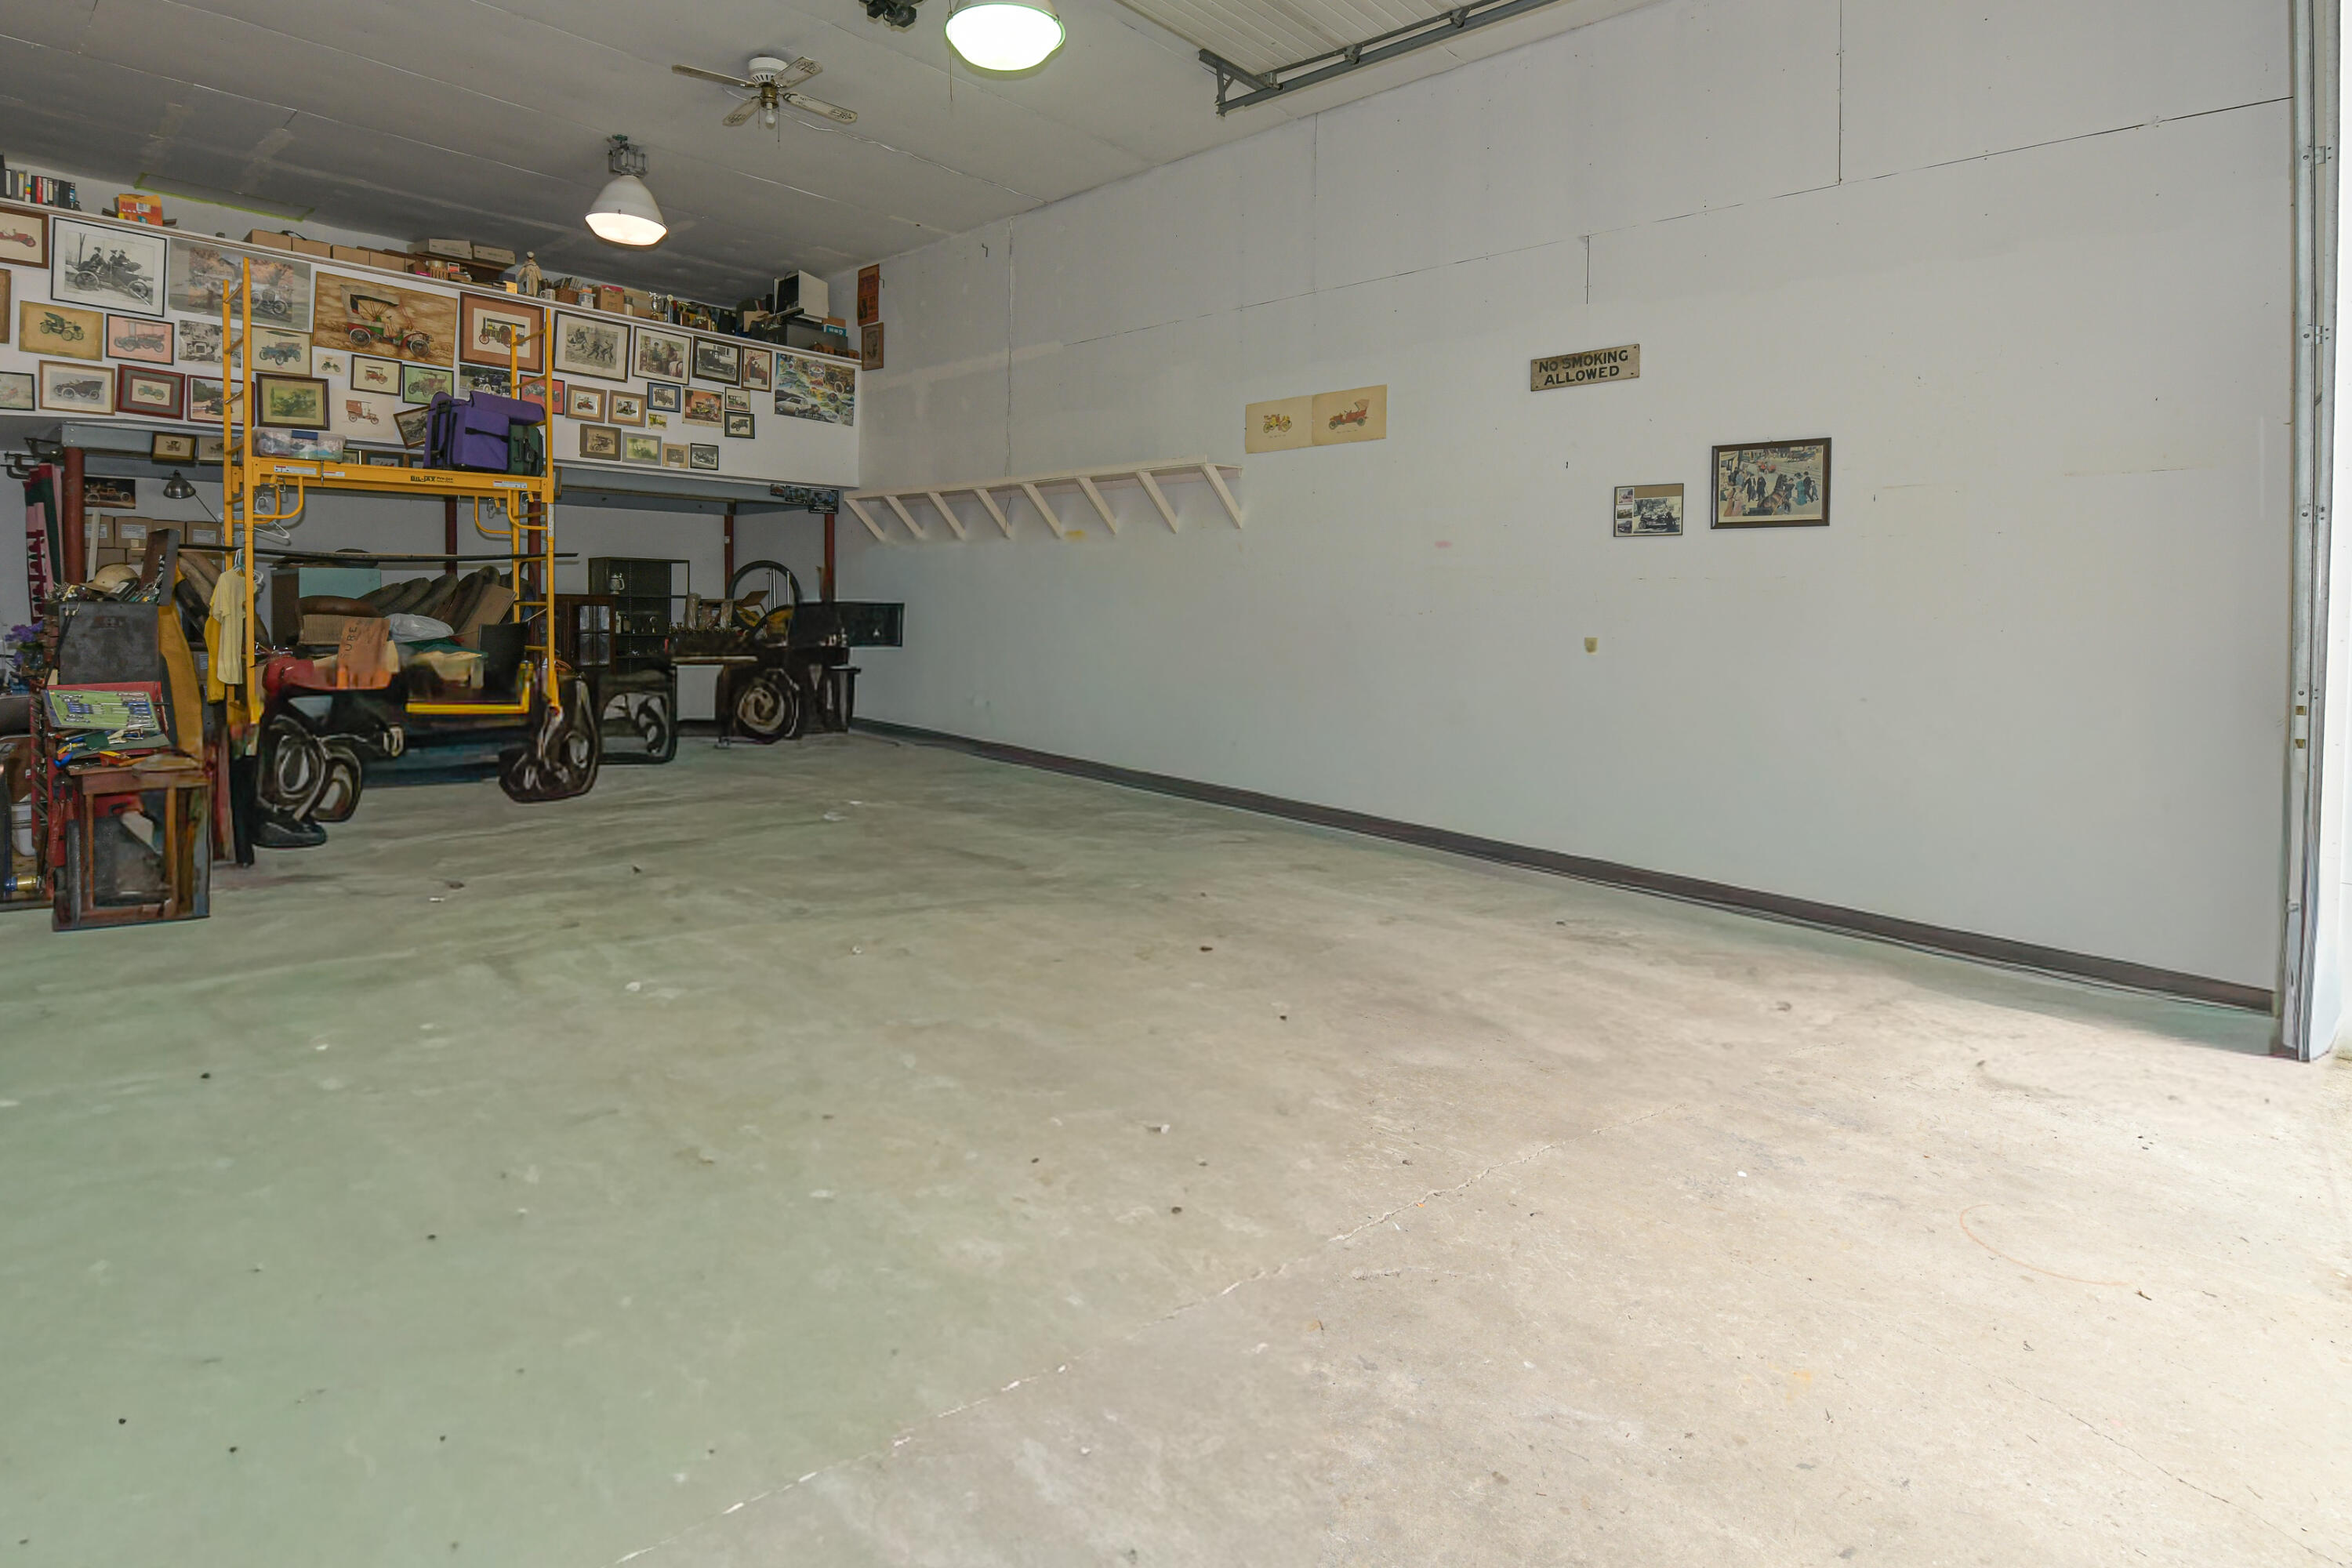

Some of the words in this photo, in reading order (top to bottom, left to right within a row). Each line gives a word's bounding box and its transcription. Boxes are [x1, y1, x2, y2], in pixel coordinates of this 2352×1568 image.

[1539, 361, 1559, 373] NO
[1562, 350, 1628, 369] SMOKING
[1544, 365, 1620, 386] ALLOWED
